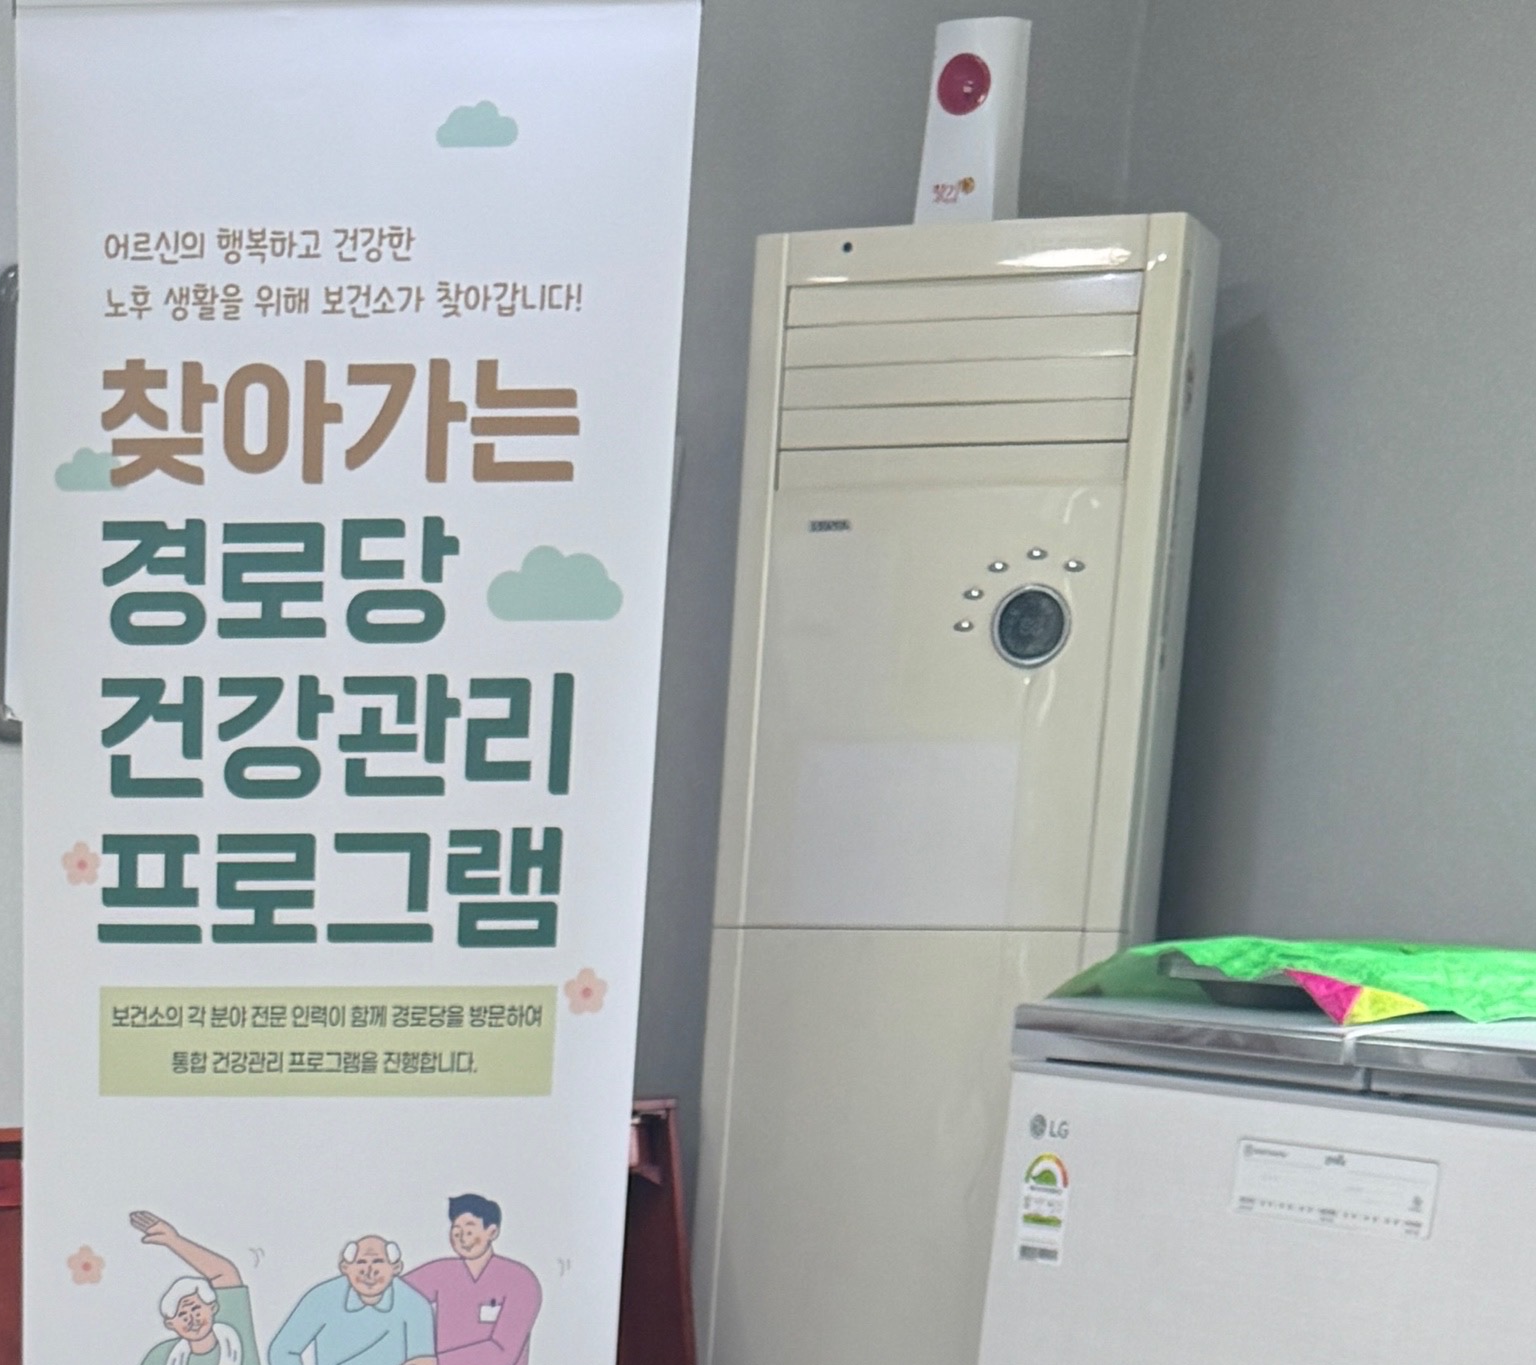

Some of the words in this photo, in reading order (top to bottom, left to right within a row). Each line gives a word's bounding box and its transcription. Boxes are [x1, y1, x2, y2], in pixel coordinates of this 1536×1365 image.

[104, 230, 205, 265] 어르신의
[216, 227, 322, 264] 행복하고
[333, 225, 416, 263] 건강한
[104, 285, 153, 320] 노후
[164, 283, 244, 322] 생활을
[254, 285, 310, 317] 위해
[321, 284, 425, 319] 보건소가
[436, 280, 583, 318] 찾아갑니다!
[100, 357, 581, 486] 찾아가는
[101, 515, 461, 646] 경로당
[100, 672, 576, 800] 건강관리
[97, 825, 564, 949] 프로그램
[111, 1005, 183, 1028] 보건소의
[187, 1005, 207, 1028] 각
[210, 1005, 247, 1028] 분야
[251, 1005, 288, 1028] 전문
[292, 1005, 346, 1028] 인력이
[350, 1004, 388, 1028] 함께
[391, 1004, 465, 1028] 경로당을
[469, 1004, 543, 1028] 방문하여
[171, 1050, 208, 1074] 통합
[212, 1050, 284, 1074] 건강관리
[287, 1050, 379, 1074] 프로그램을
[383, 1050, 478, 1074] 진행합니다.
